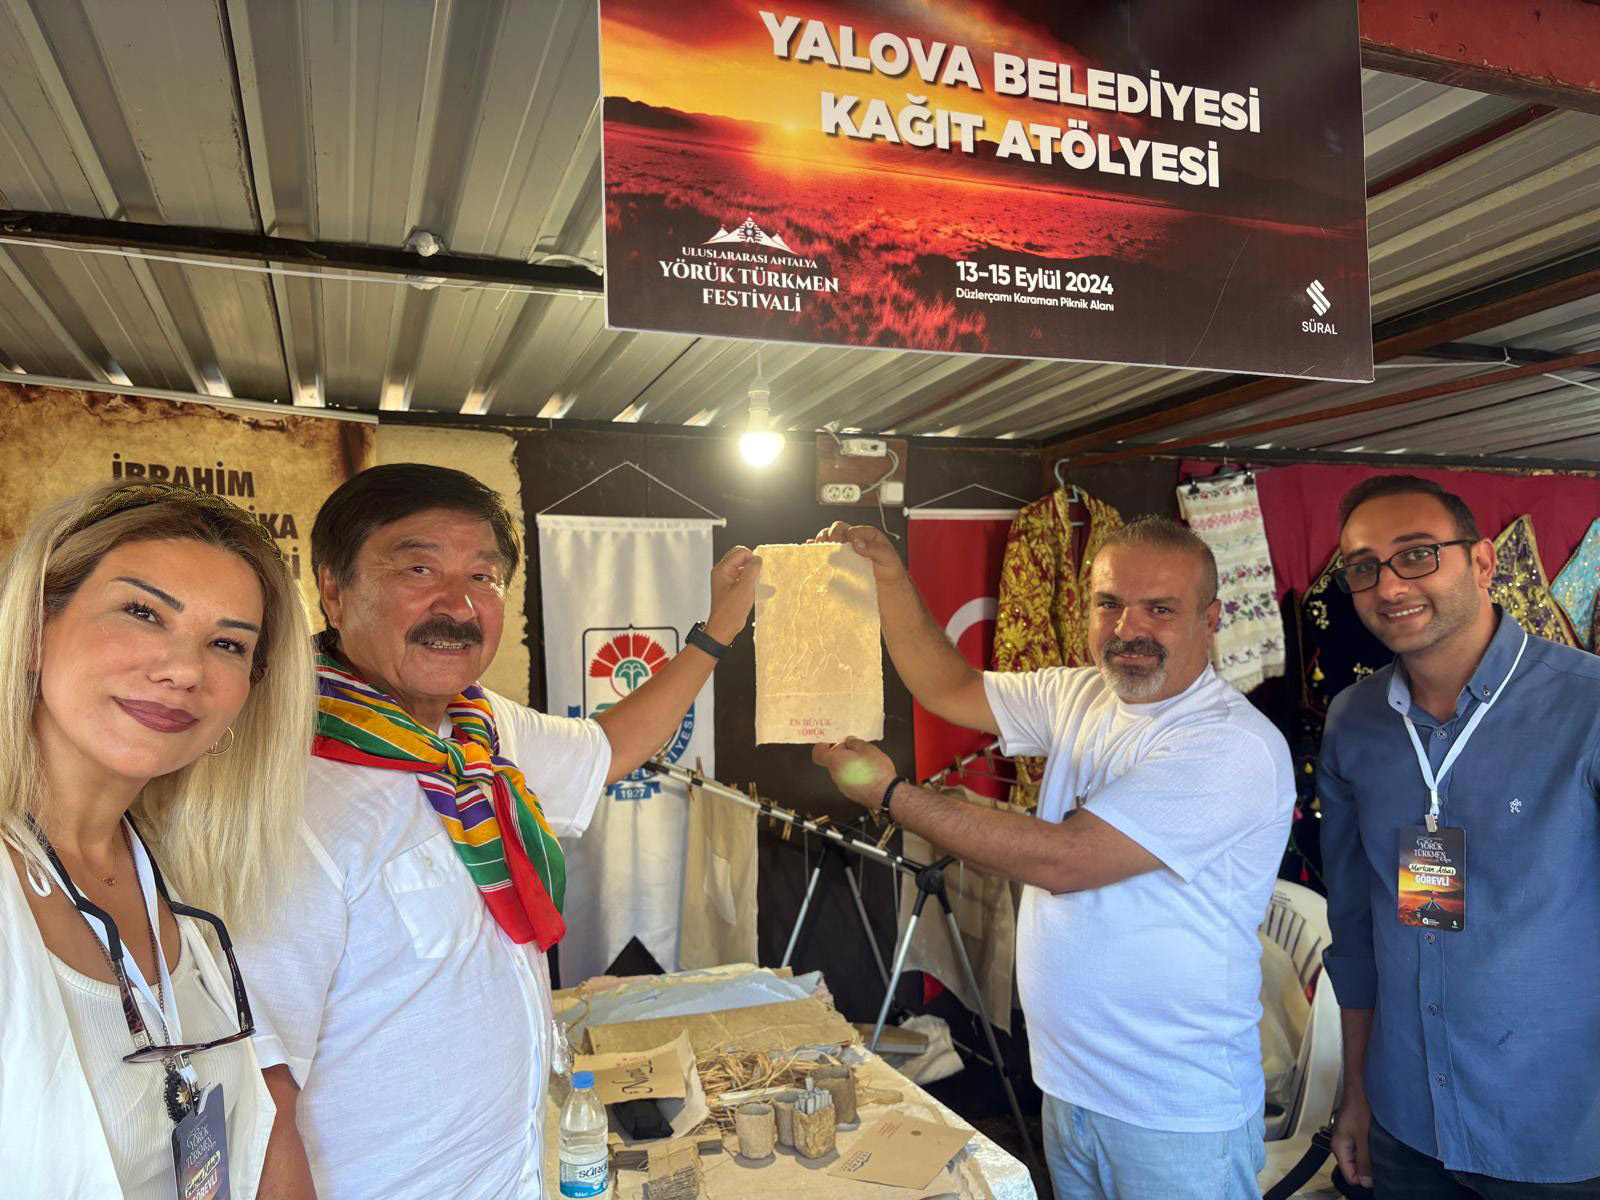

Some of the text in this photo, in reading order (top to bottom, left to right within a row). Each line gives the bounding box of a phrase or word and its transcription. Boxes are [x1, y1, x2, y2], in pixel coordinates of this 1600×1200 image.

[759, 11, 1261, 134] YALOVA BELEDİYESİ
[820, 92, 1220, 188] KAĞIT ATÖLYESİ
[682, 246, 818, 269] ULUSLARARASI ANTALYA
[658, 258, 839, 293] YÖRÜK TÜRKMEN
[955, 260, 1114, 296] 13-15 Eylül 2024
[702, 287, 802, 312] FESTİVALİ
[955, 287, 1114, 312] Düzlerçamı Karaman Piknik Alanı
[1301, 320, 1338, 336] SÜRAL
[620, 787, 647, 799] 1927
[1415, 874, 1450, 887] GÖREVLİ
[192, 1168, 218, 1200] ÖREVLİ
